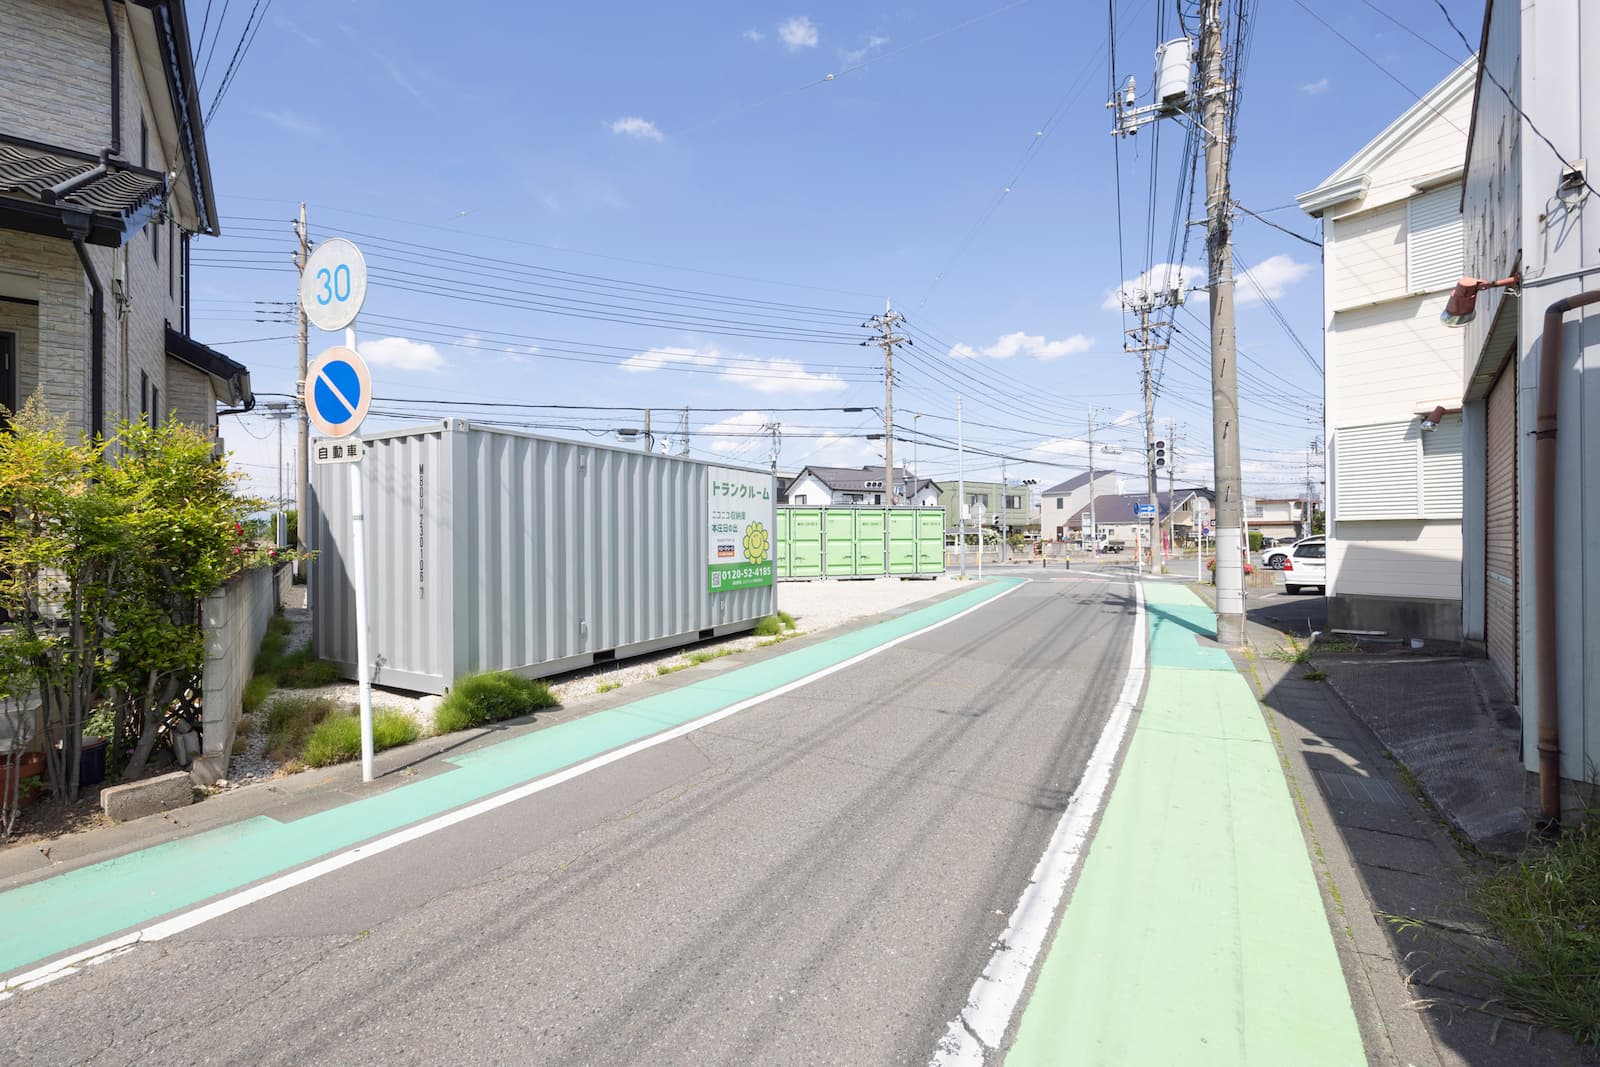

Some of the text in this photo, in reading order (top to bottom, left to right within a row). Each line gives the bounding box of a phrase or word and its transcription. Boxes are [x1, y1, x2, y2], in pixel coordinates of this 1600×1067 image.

[316, 263, 351, 306] 30
[318, 444, 358, 460] 自動車
[712, 480, 770, 500] トランクルーム
[721, 566, 772, 580] 0120-52-4185
